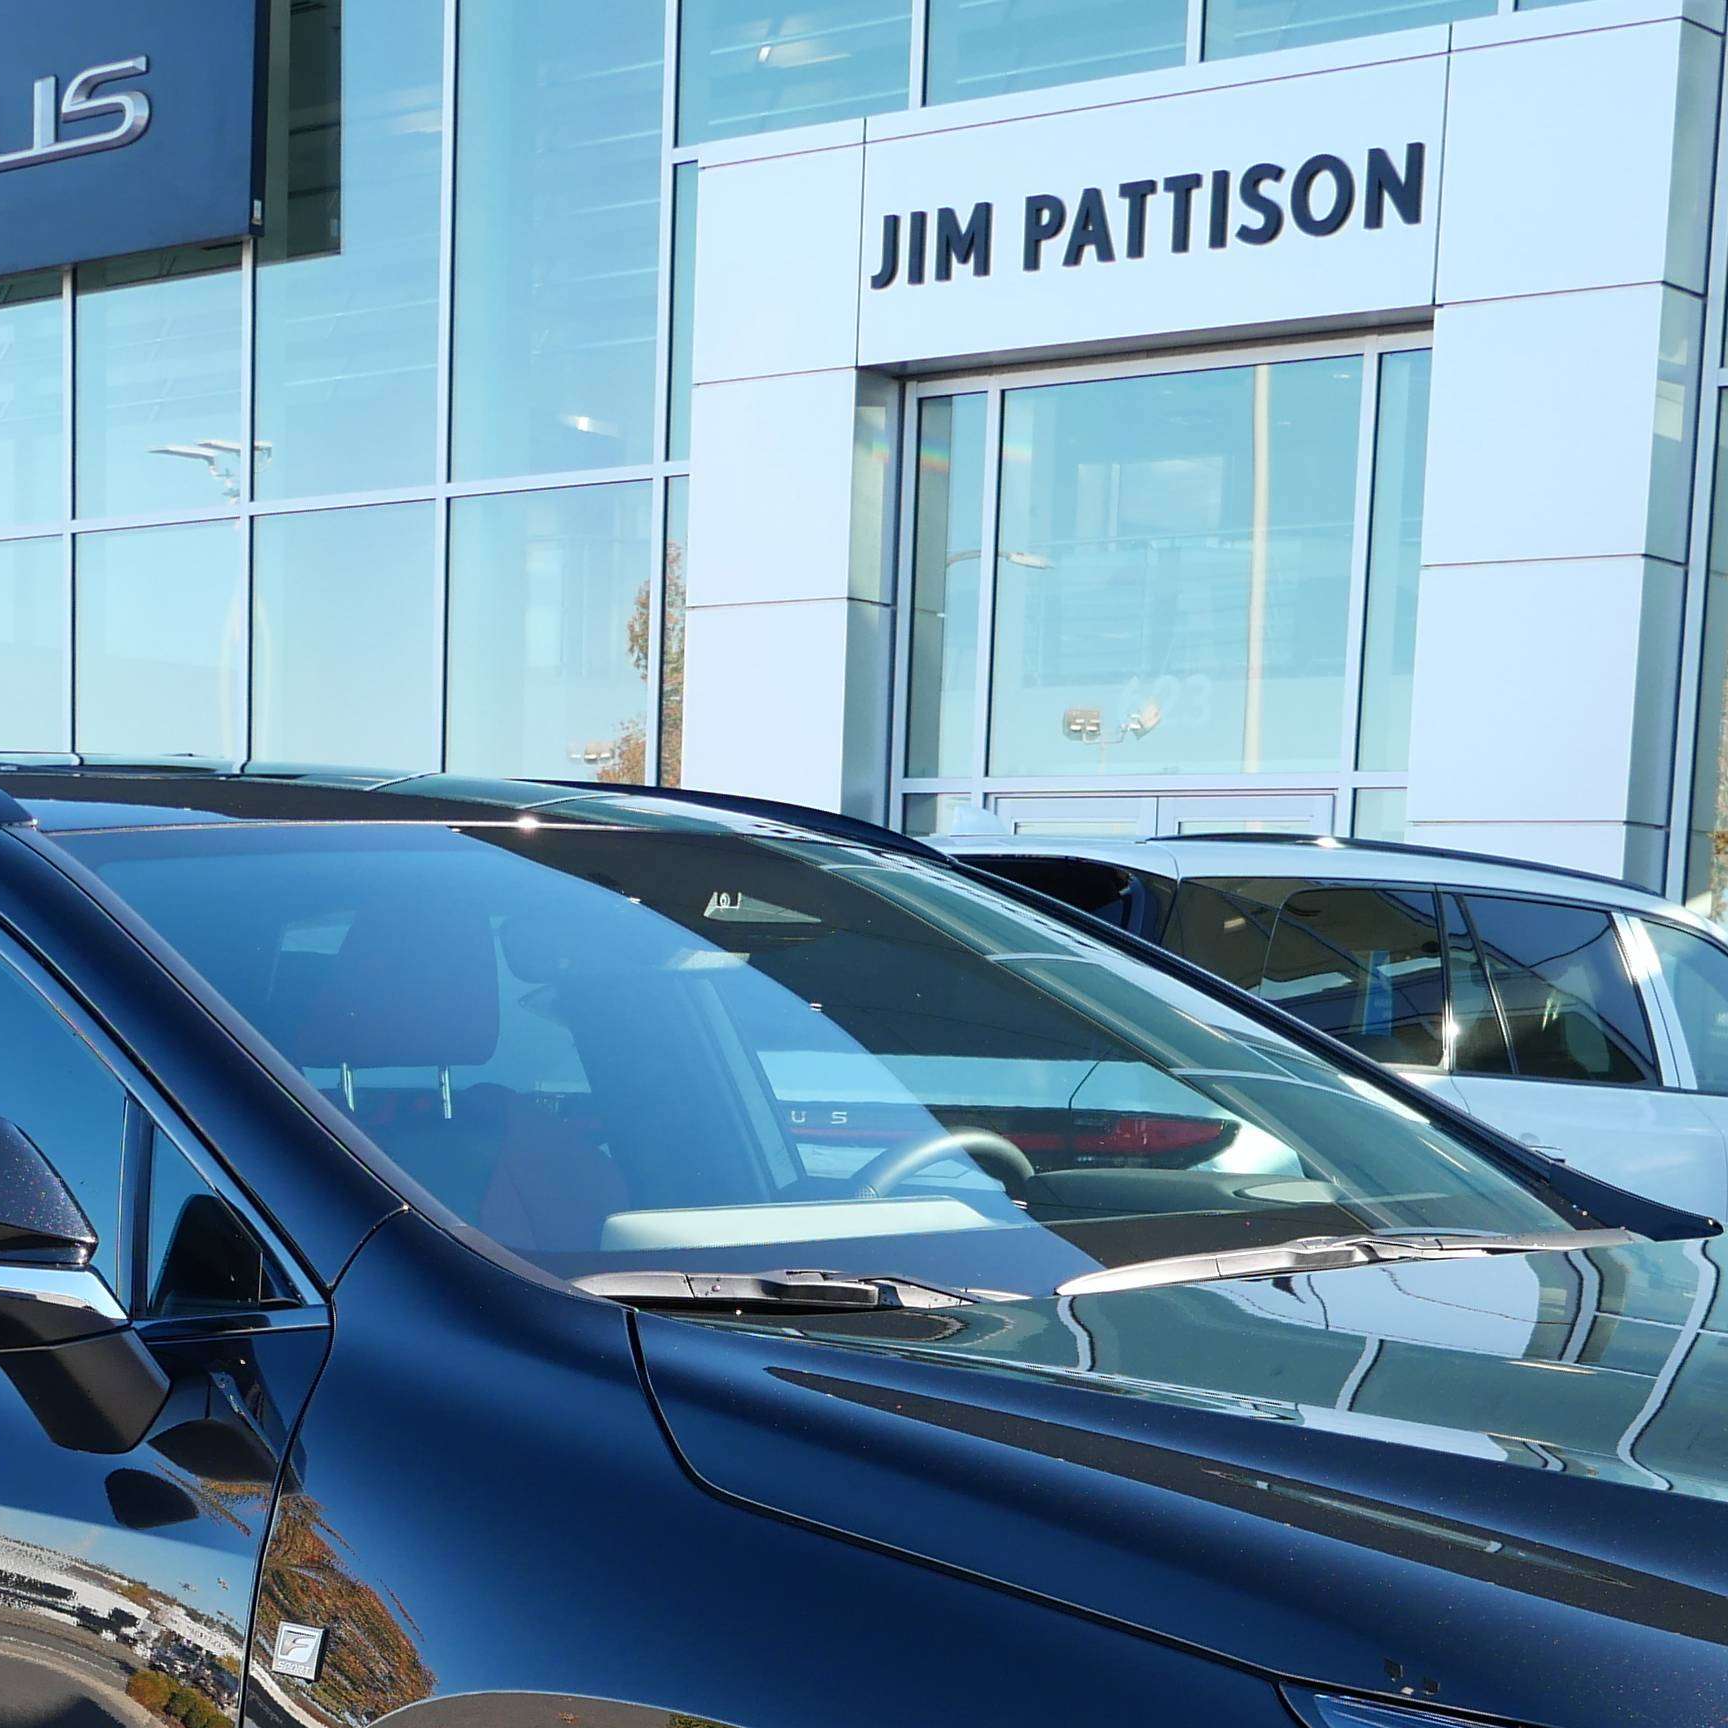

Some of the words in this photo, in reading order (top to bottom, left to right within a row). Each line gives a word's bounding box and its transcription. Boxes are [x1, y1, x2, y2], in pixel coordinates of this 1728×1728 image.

[870, 201, 994, 290] JIM
[1022, 141, 1426, 272] PATTISON
[276, 1661, 312, 1677] SPORT
